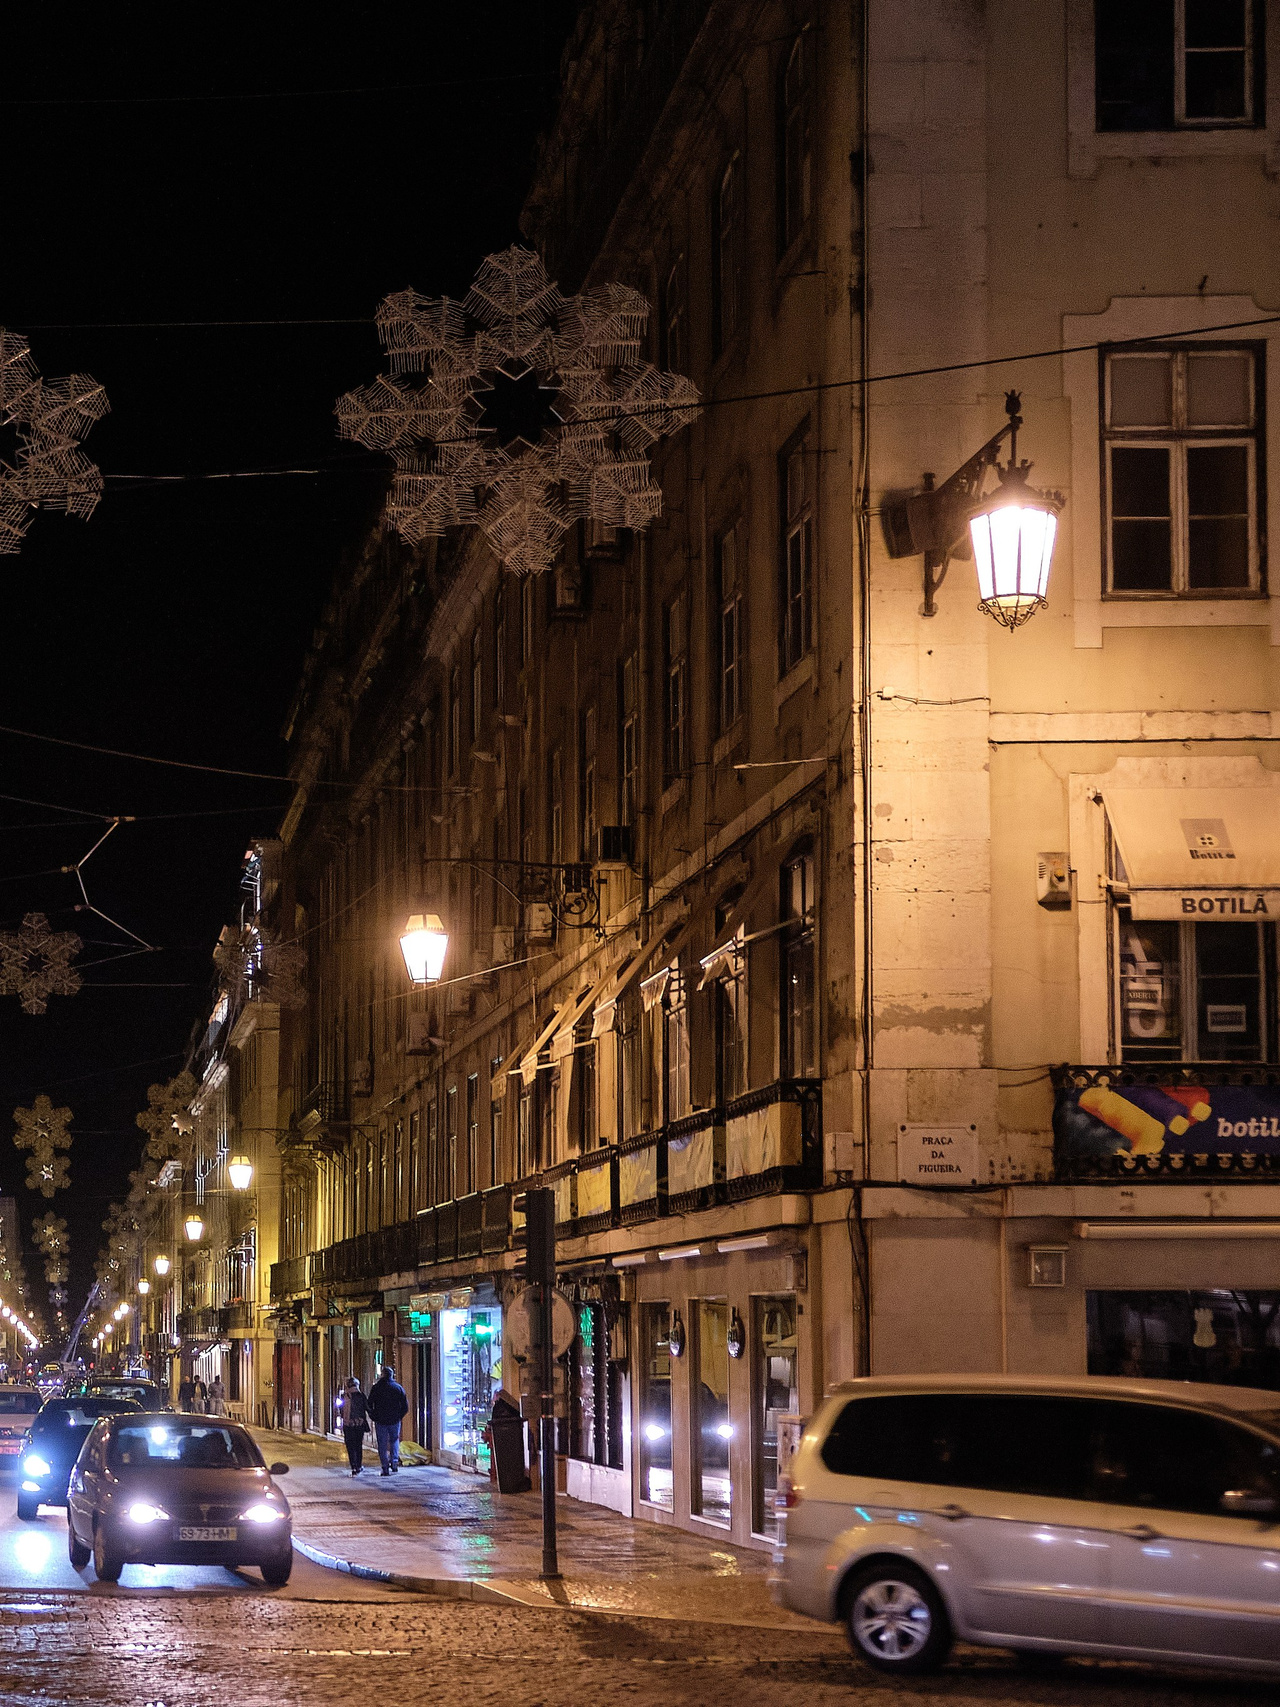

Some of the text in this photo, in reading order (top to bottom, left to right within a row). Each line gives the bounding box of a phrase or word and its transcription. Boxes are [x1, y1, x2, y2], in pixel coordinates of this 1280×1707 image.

[1181, 894, 1268, 914] BOTILÃ
[1217, 1116, 1280, 1138] botil
[931, 1150, 945, 1159] DA
[918, 1164, 962, 1173] FIGUEIRA
